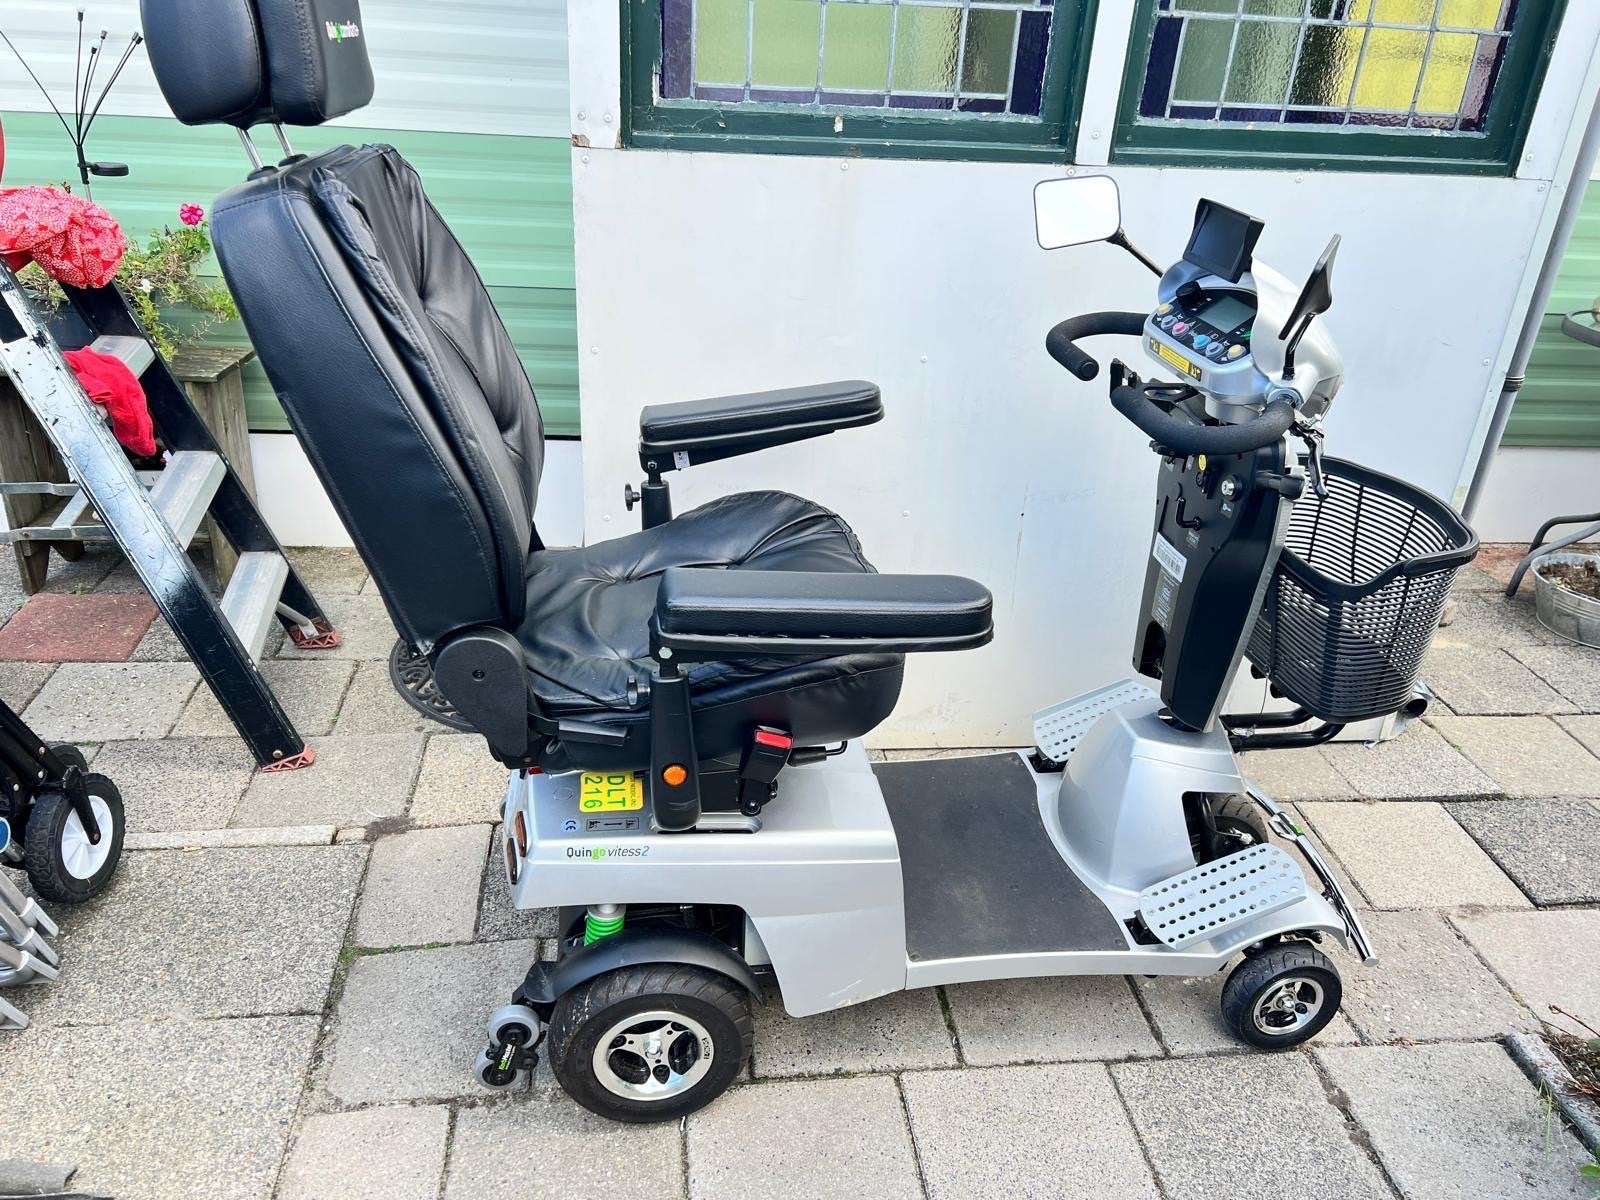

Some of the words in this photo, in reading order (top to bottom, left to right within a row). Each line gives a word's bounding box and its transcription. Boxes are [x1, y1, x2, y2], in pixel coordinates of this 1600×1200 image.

[583, 776, 603, 809] 216
[607, 775, 626, 807] DLT
[566, 847, 606, 860] Quingo
[607, 845, 650, 857] vitess2
